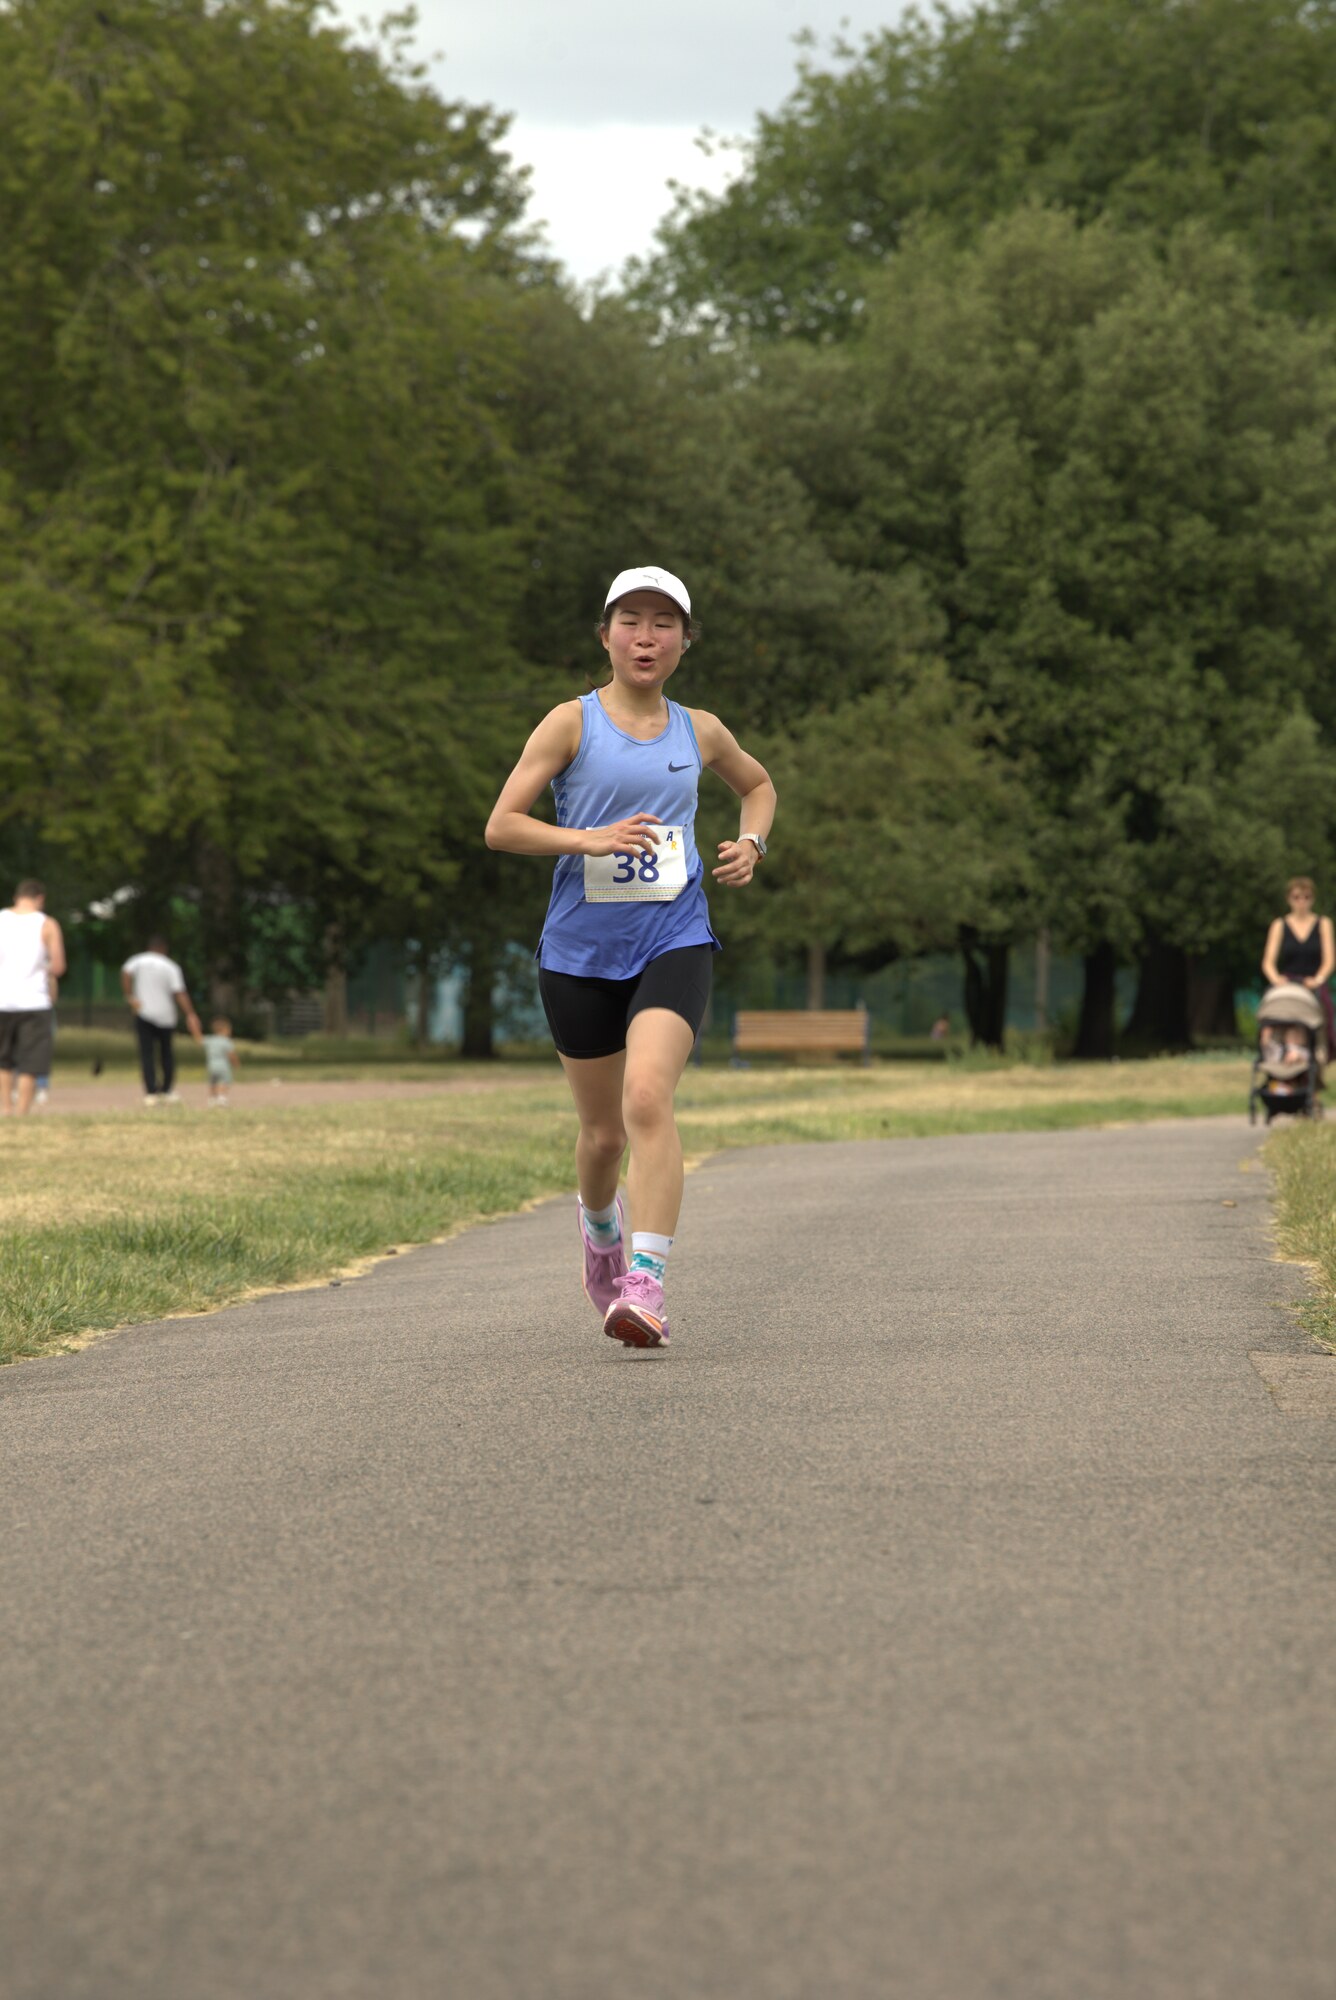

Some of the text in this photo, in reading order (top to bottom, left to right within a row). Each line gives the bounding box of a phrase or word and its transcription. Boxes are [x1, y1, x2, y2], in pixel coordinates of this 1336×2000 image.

[666, 831, 674, 841] A
[671, 841, 677, 850] R
[612, 850, 660, 884] 38
